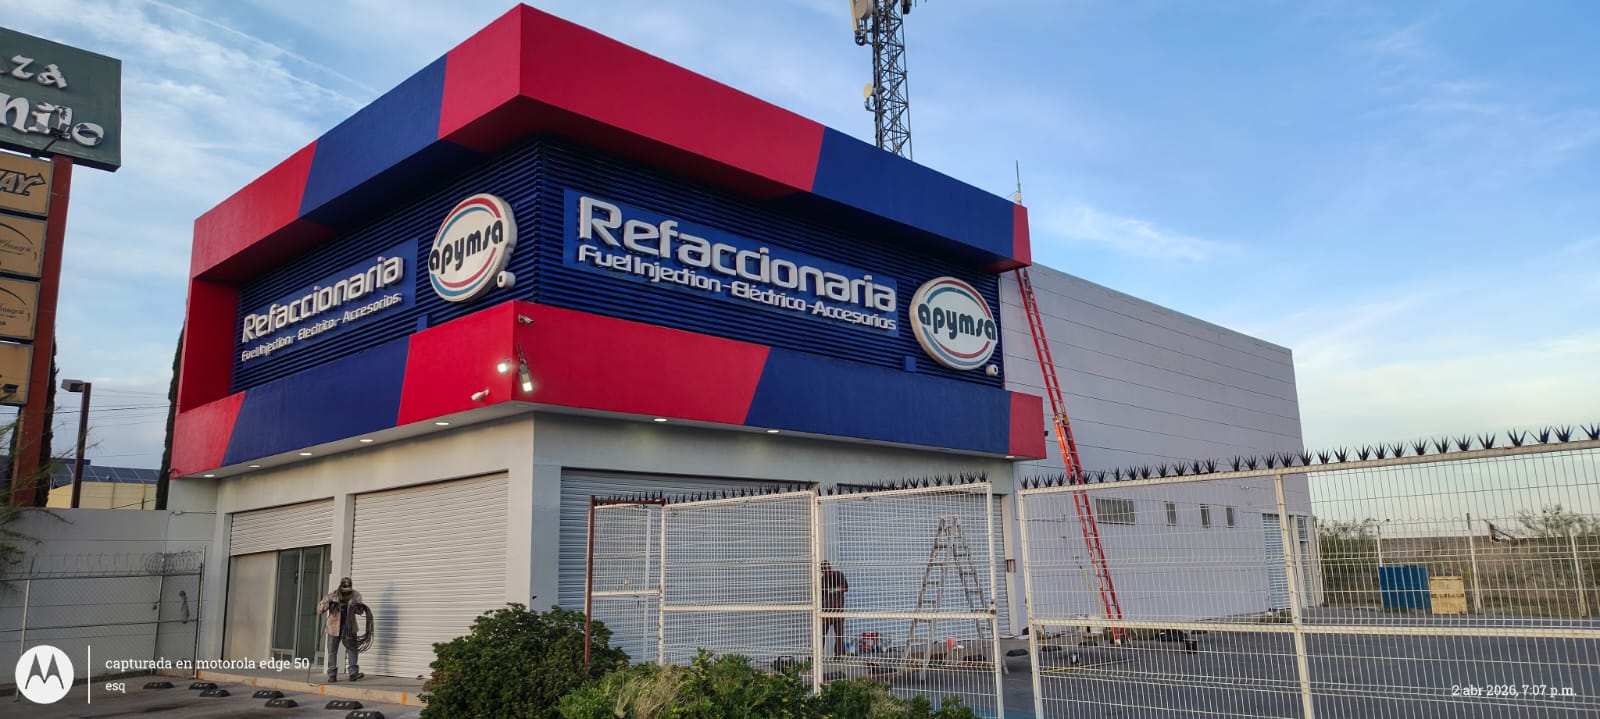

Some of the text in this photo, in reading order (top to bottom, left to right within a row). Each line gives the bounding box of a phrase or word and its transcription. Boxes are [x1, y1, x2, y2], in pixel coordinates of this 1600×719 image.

[0, 54, 67, 88] za
[428, 218, 503, 275] apymsa
[578, 244, 631, 272] Fuel
[579, 196, 896, 312] Refaccionaria
[242, 256, 403, 343] Refaccionaria
[342, 293, 402, 323] Accesorios
[918, 302, 997, 340] apymsa
